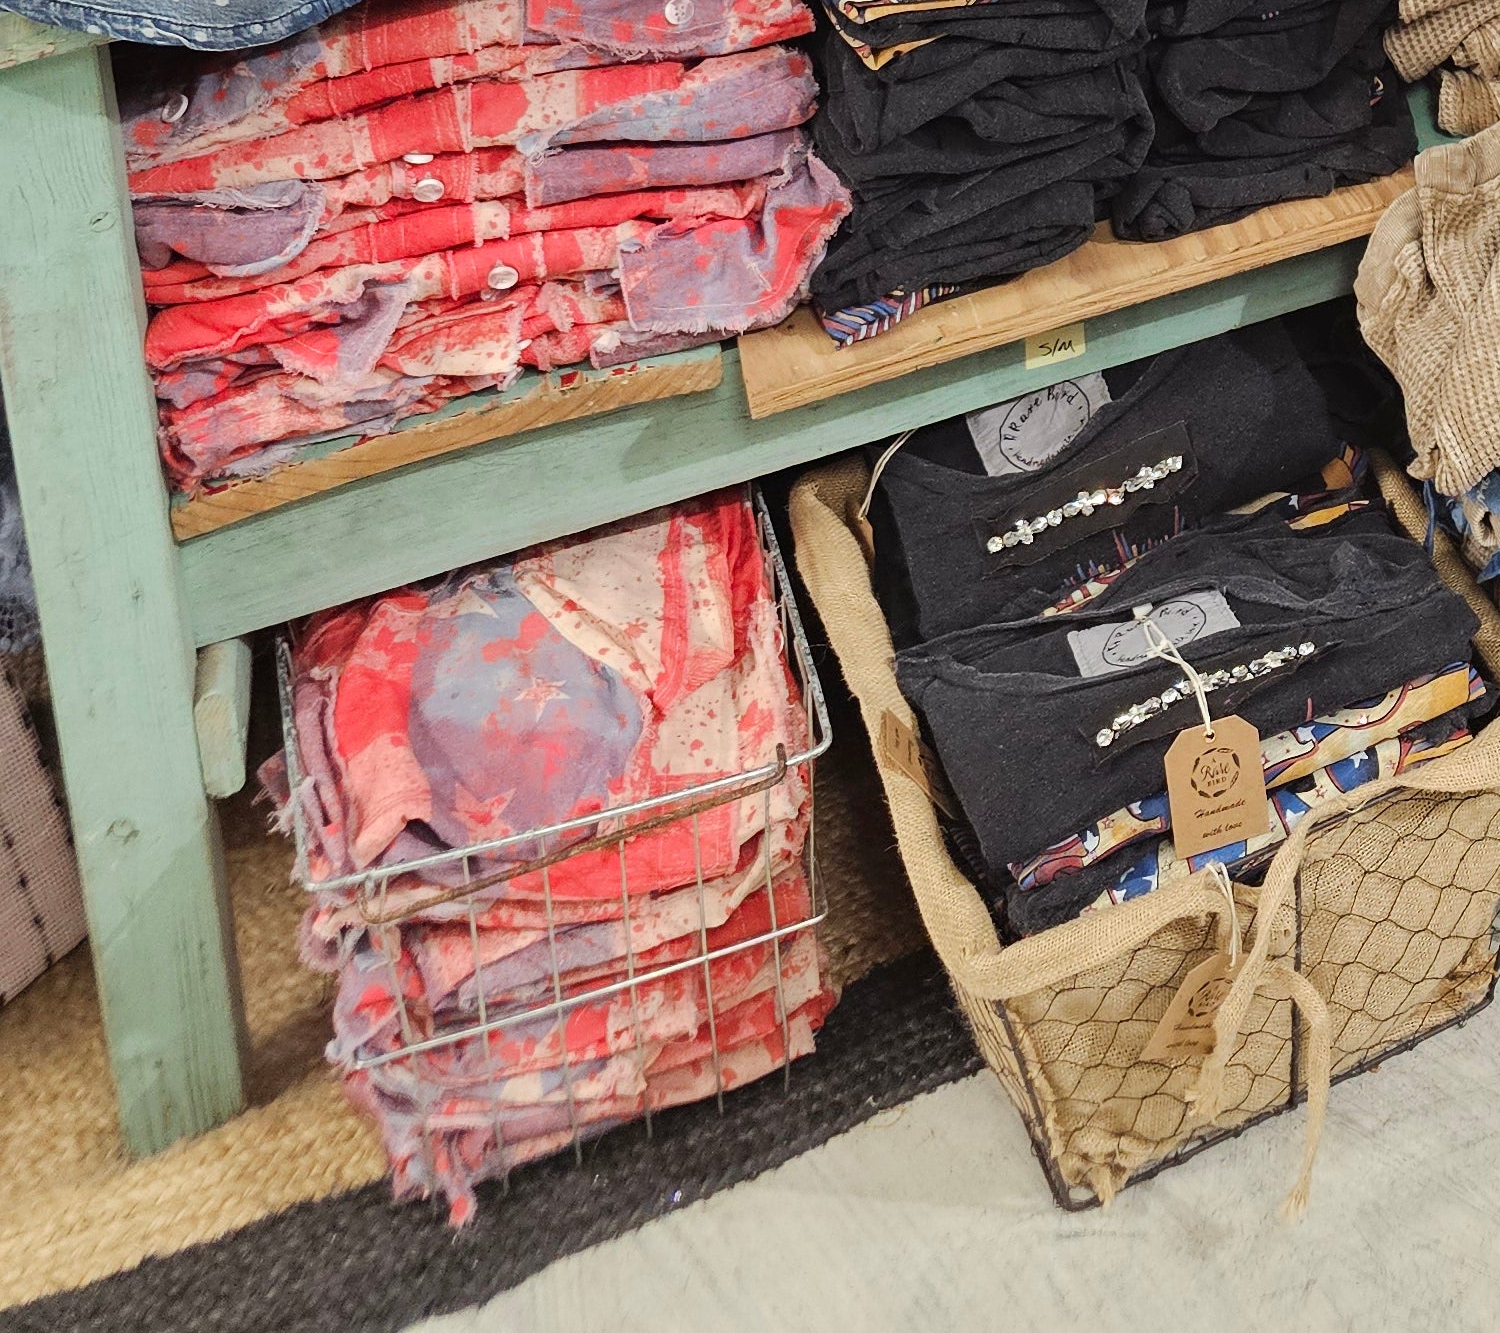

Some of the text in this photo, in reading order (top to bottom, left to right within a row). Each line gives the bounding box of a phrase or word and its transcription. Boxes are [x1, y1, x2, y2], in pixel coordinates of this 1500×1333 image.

[1038, 338, 1075, 357] S/M
[1008, 396, 1043, 432] Rare
[1046, 384, 1079, 406] Bird
[1194, 798, 1246, 819] Handmade
[1202, 821, 1242, 839] with love
